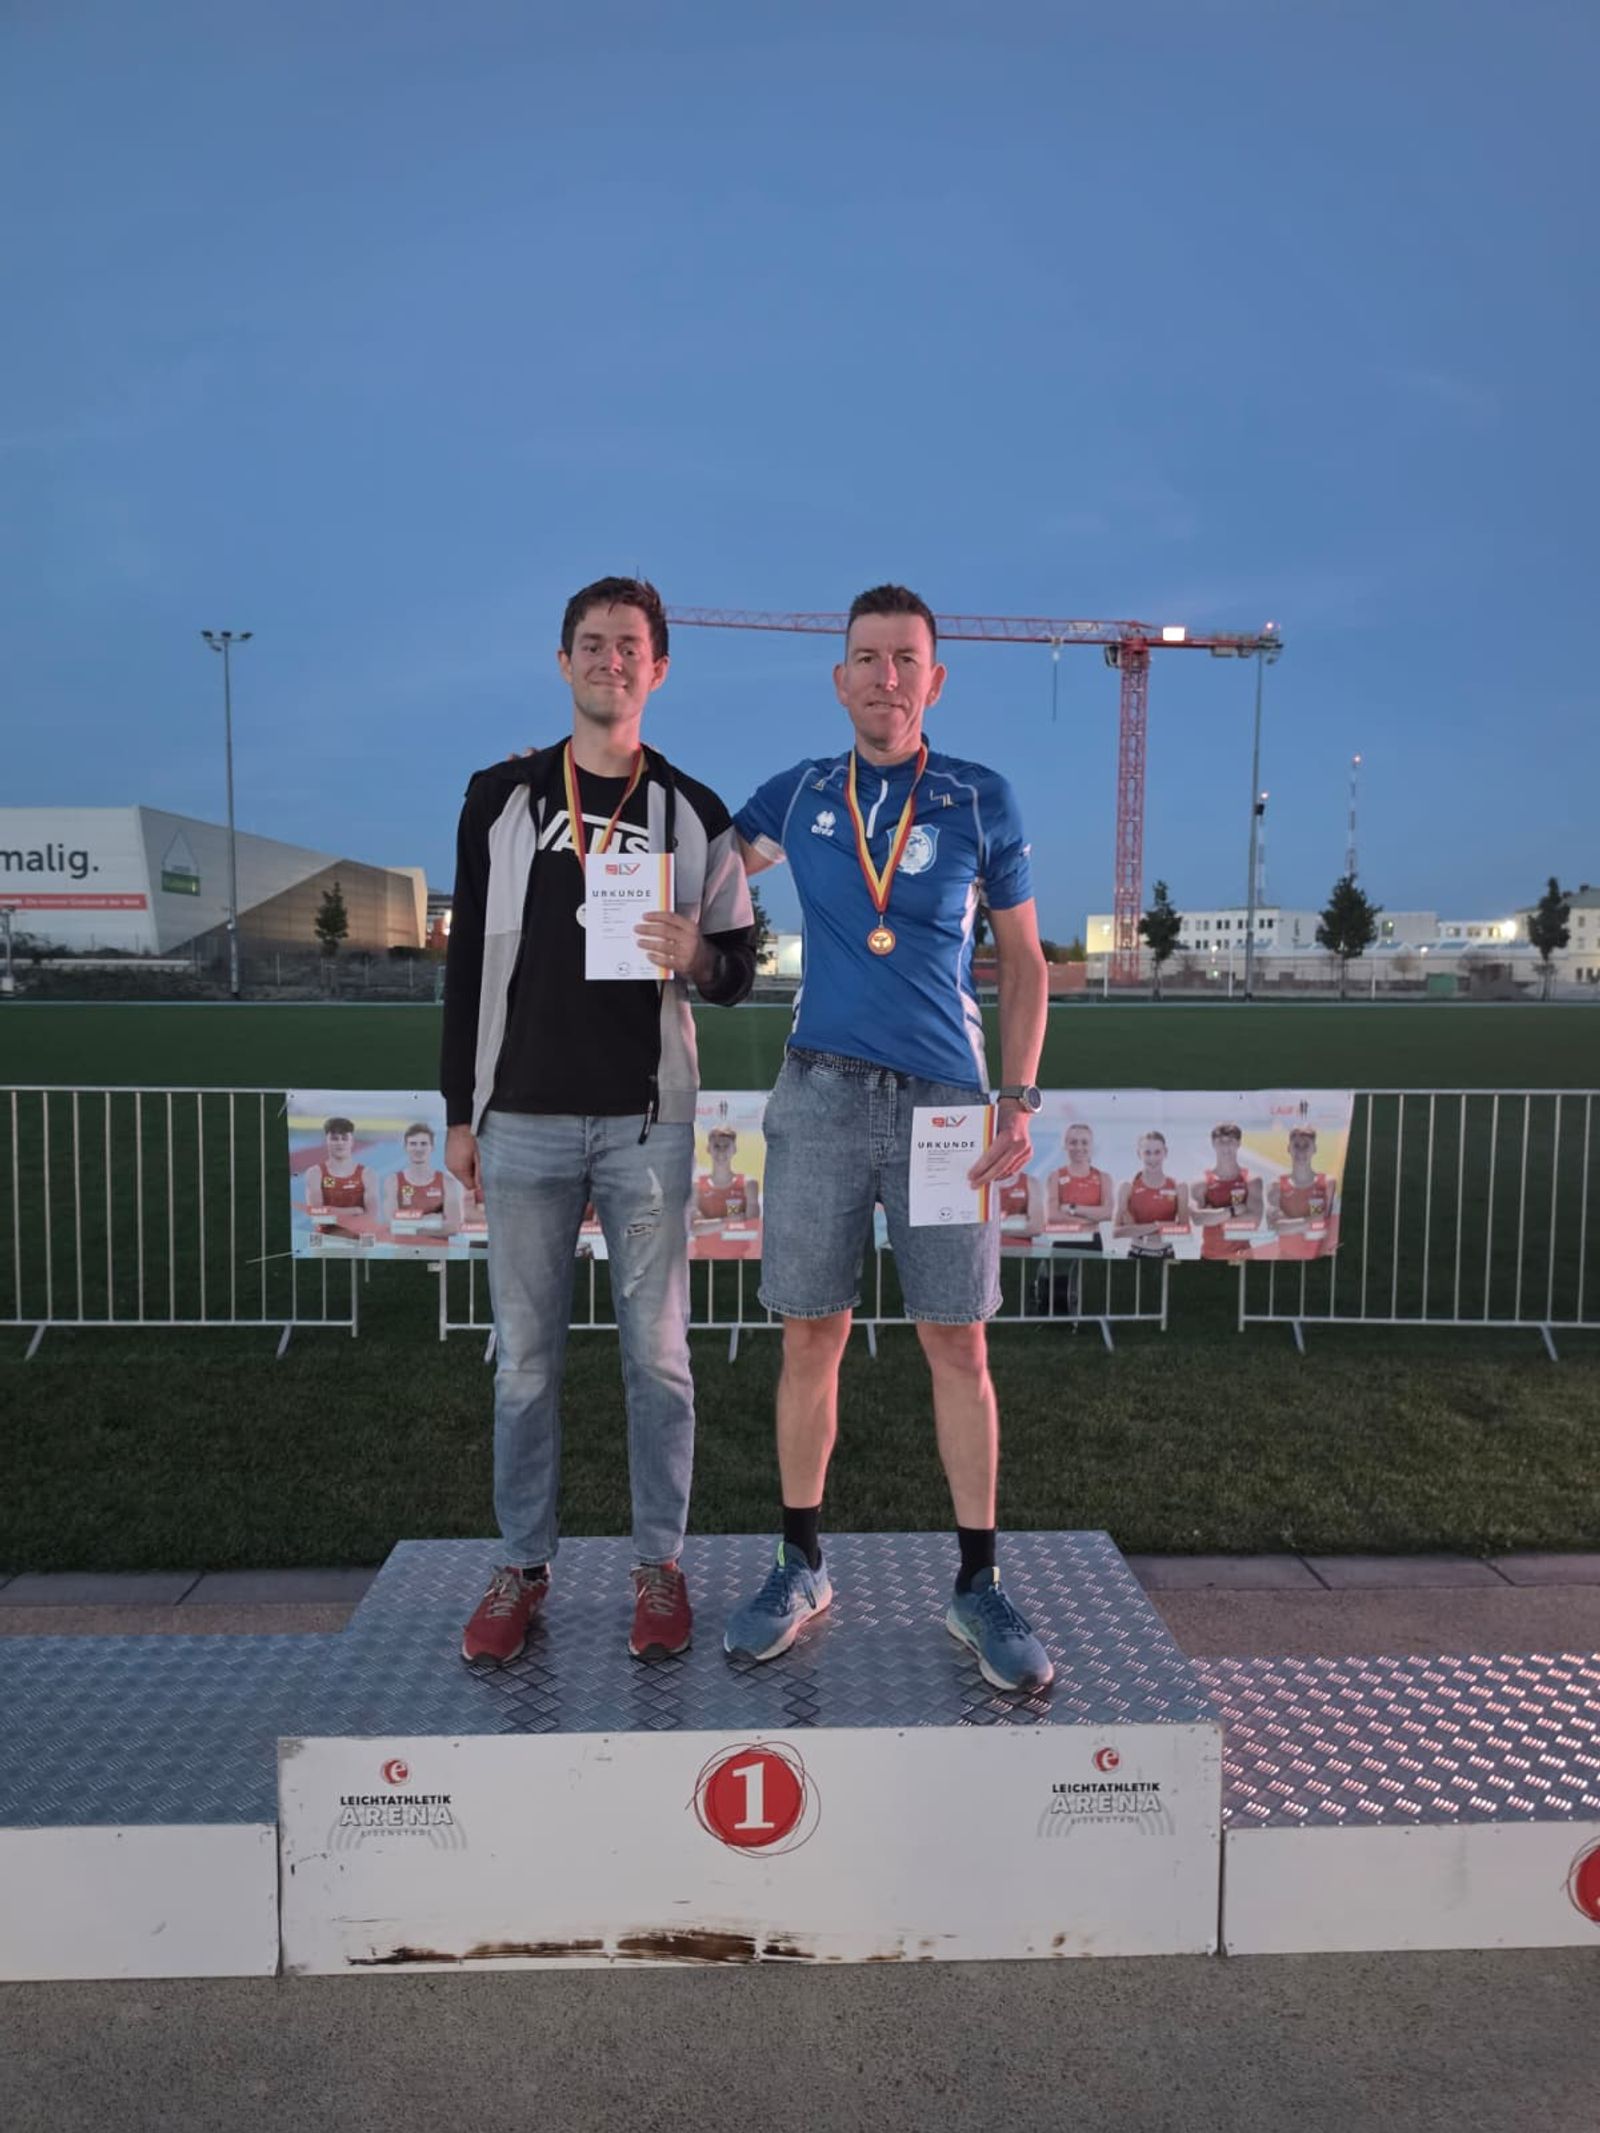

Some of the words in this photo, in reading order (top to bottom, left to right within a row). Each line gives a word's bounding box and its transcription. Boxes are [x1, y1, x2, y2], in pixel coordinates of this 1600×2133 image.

[0, 843, 99, 880] malig.
[592, 889, 652, 898] URKUNDE
[917, 1141, 976, 1149] URKUNDE
[731, 1761, 775, 1830] 1
[1052, 1783, 1160, 1793] LEICHTATHLETIK
[340, 1795, 451, 1805] LEICHTATHLETIK
[1051, 1793, 1161, 1814] ARENA
[340, 1805, 454, 1826] ARENA
